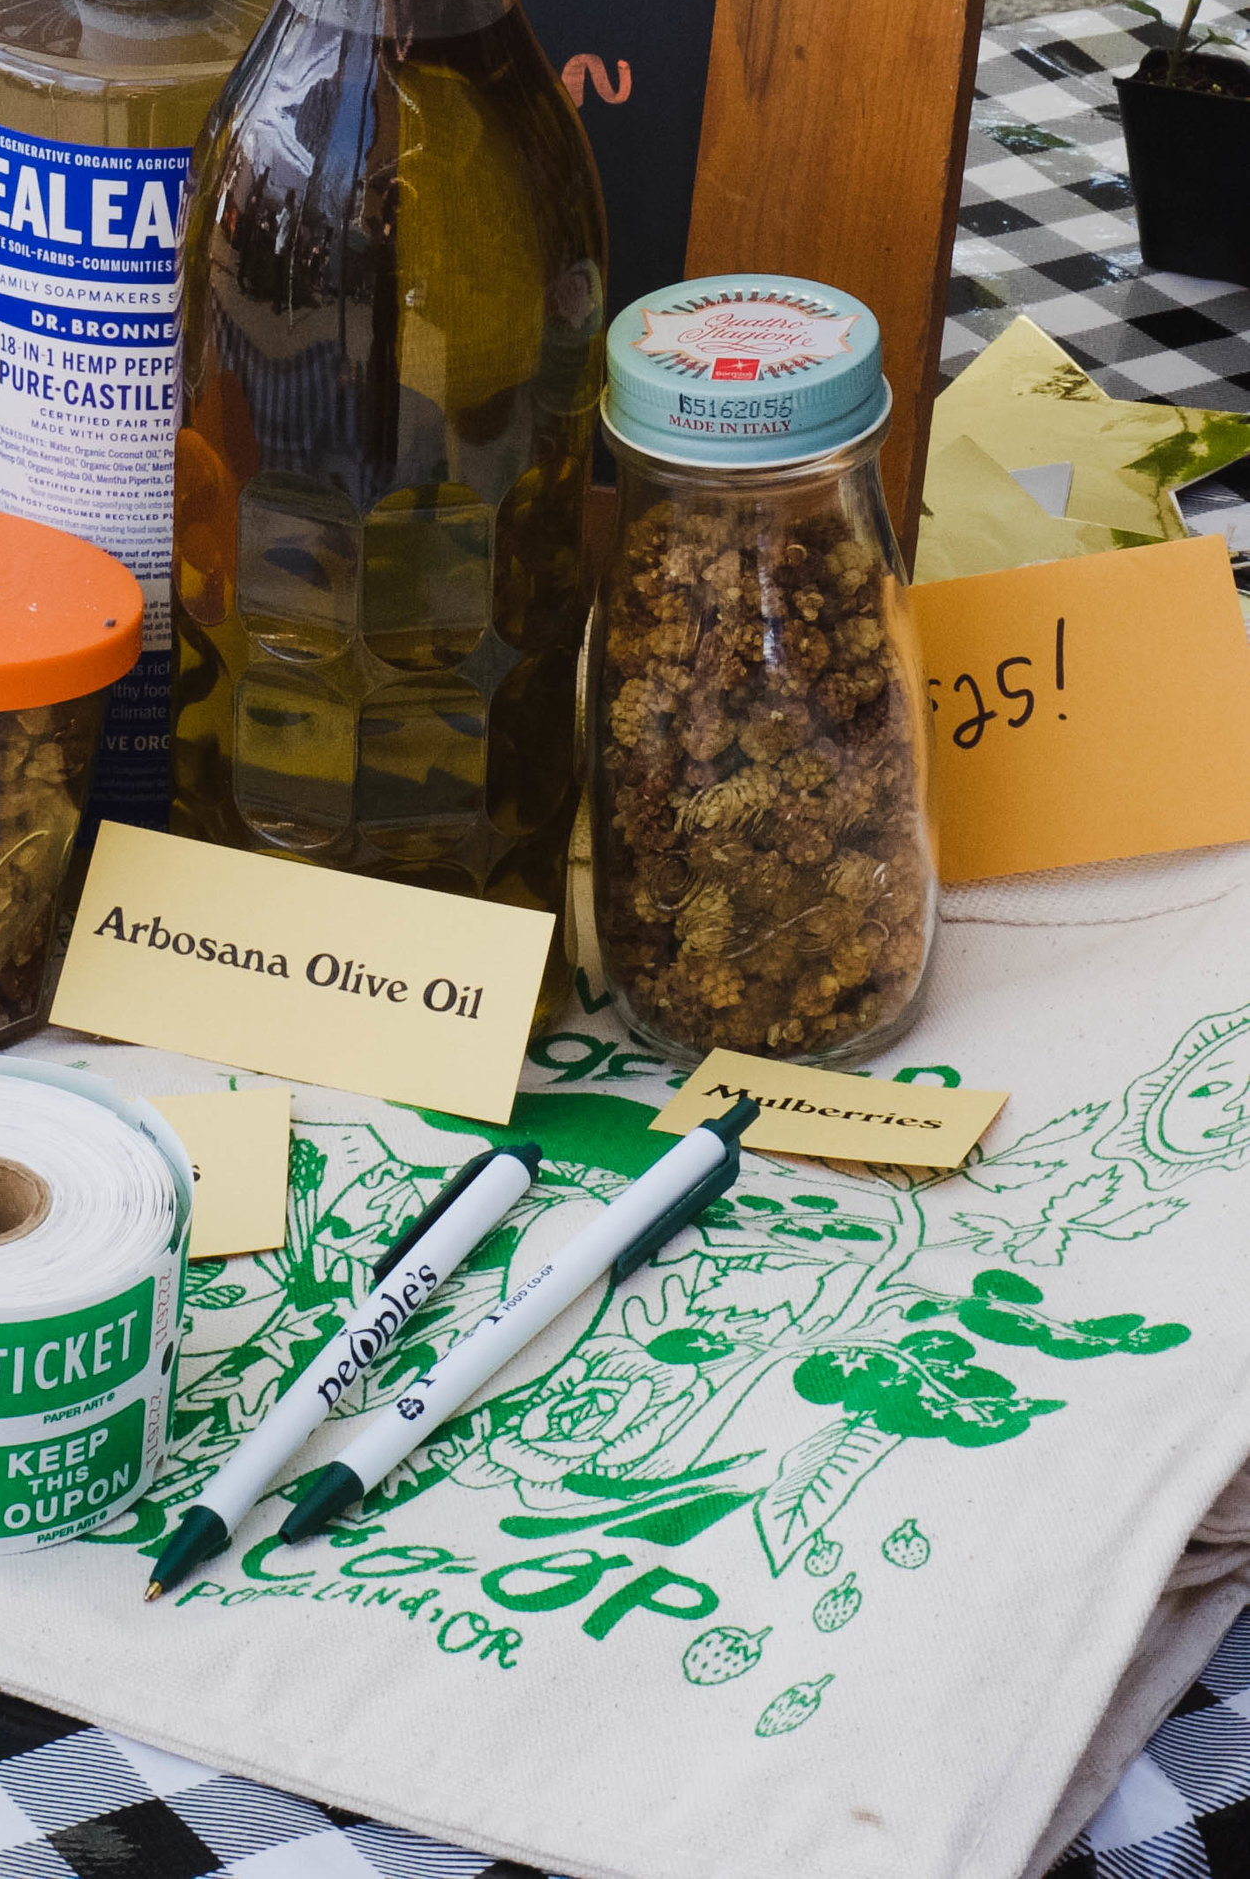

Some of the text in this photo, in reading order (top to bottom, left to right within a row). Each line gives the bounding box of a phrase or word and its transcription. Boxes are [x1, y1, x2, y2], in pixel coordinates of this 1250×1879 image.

[75, 154, 132, 170] ORGANIC
[44, 284, 161, 304] SOAPMAKERS
[31, 309, 175, 340] DR. BRONNE
[0, 333, 174, 377] 18-IN-1 HEMP PEPP
[0, 359, 174, 411] PURE-CASTILE
[31, 419, 174, 443] MADE WITH ORGANIC
[40, 408, 110, 427] CERTIFIED
[116, 419, 148, 428] FAIR
[668, 414, 792, 435] MADE IN ITALY
[74, 446, 106, 458] Organic
[108, 450, 143, 459] Coconut
[80, 458, 111, 471] Organic
[113, 461, 132, 472] Olive
[97, 474, 127, 485] Mentha
[21, 495, 101, 519] POST-CONSUMER
[105, 513, 159, 521] RECYCLED
[106, 491, 140, 499] TRADE
[93, 905, 485, 1020] Arbosana Olive Oil
[702, 1083, 943, 1130] Mulberries
[43, 1395, 106, 1424] PAPER ART
[7, 1428, 109, 1479] KEEP
[28, 1465, 90, 1495] THIS
[37, 1515, 100, 1544] PAPER ART
